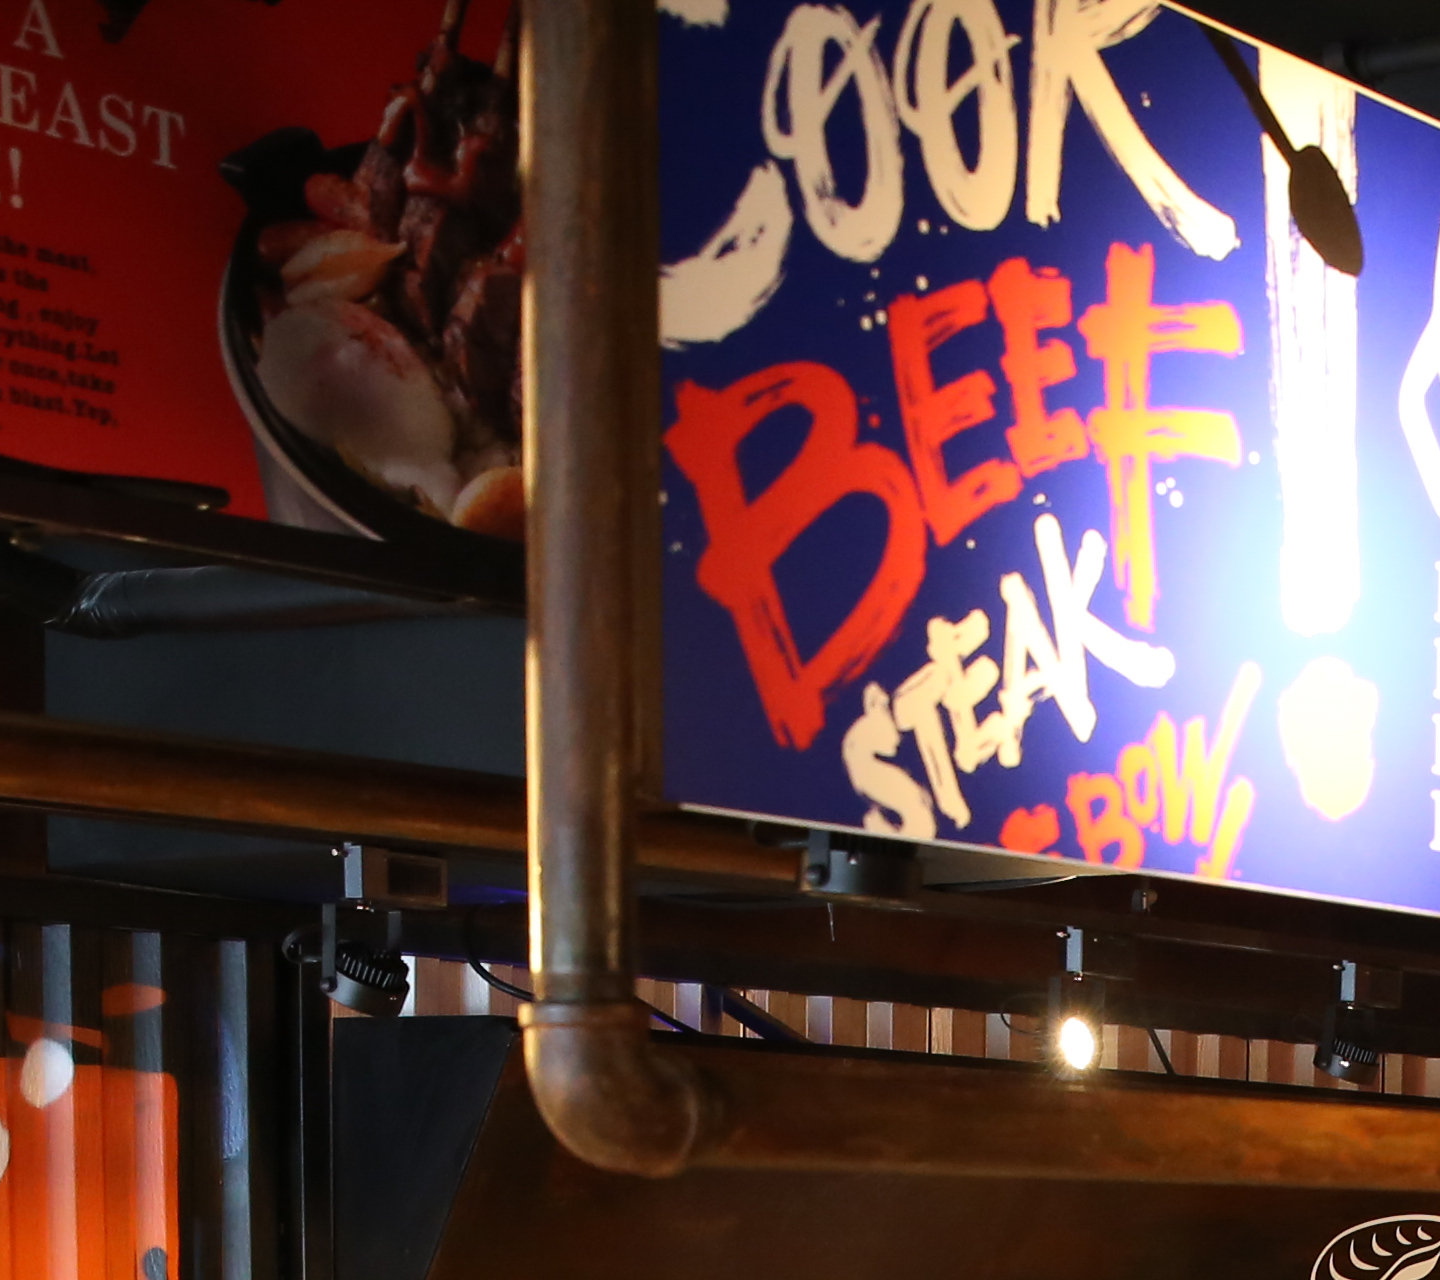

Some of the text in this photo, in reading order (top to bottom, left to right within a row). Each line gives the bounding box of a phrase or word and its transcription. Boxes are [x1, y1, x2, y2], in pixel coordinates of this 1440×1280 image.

[14, 268, 50, 292] the
[661, 242, 1244, 753] BEEF
[842, 512, 1176, 842] STEAK
